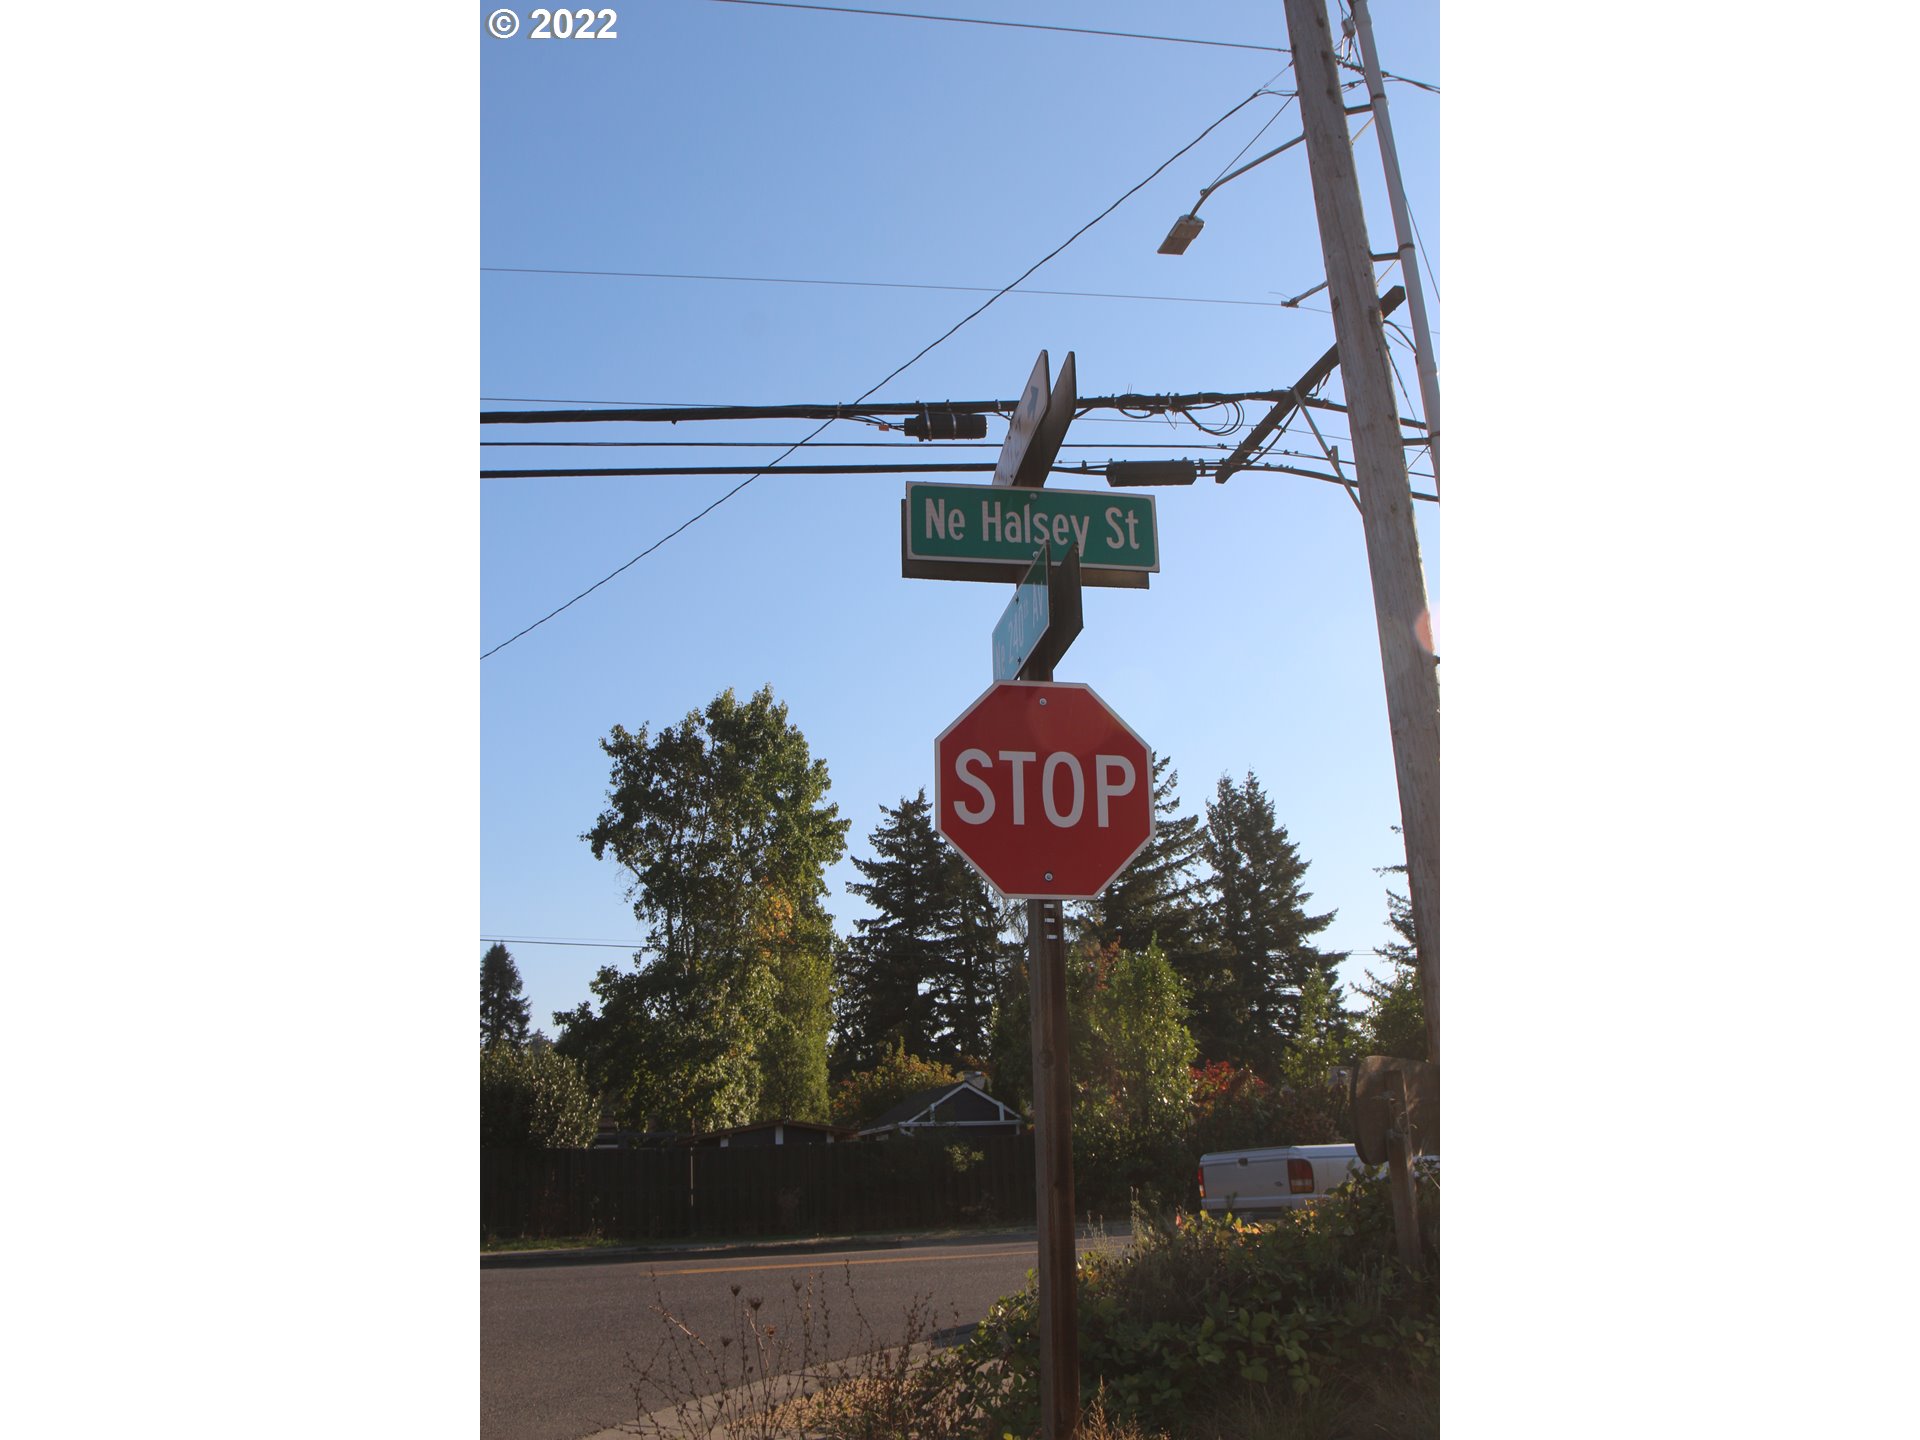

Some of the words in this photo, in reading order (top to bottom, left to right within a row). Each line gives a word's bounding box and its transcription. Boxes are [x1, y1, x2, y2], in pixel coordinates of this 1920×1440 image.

[925, 498, 966, 541] Ne
[982, 501, 1090, 557] Halsey
[1105, 507, 1141, 550] St
[952, 747, 1137, 829] STOP
